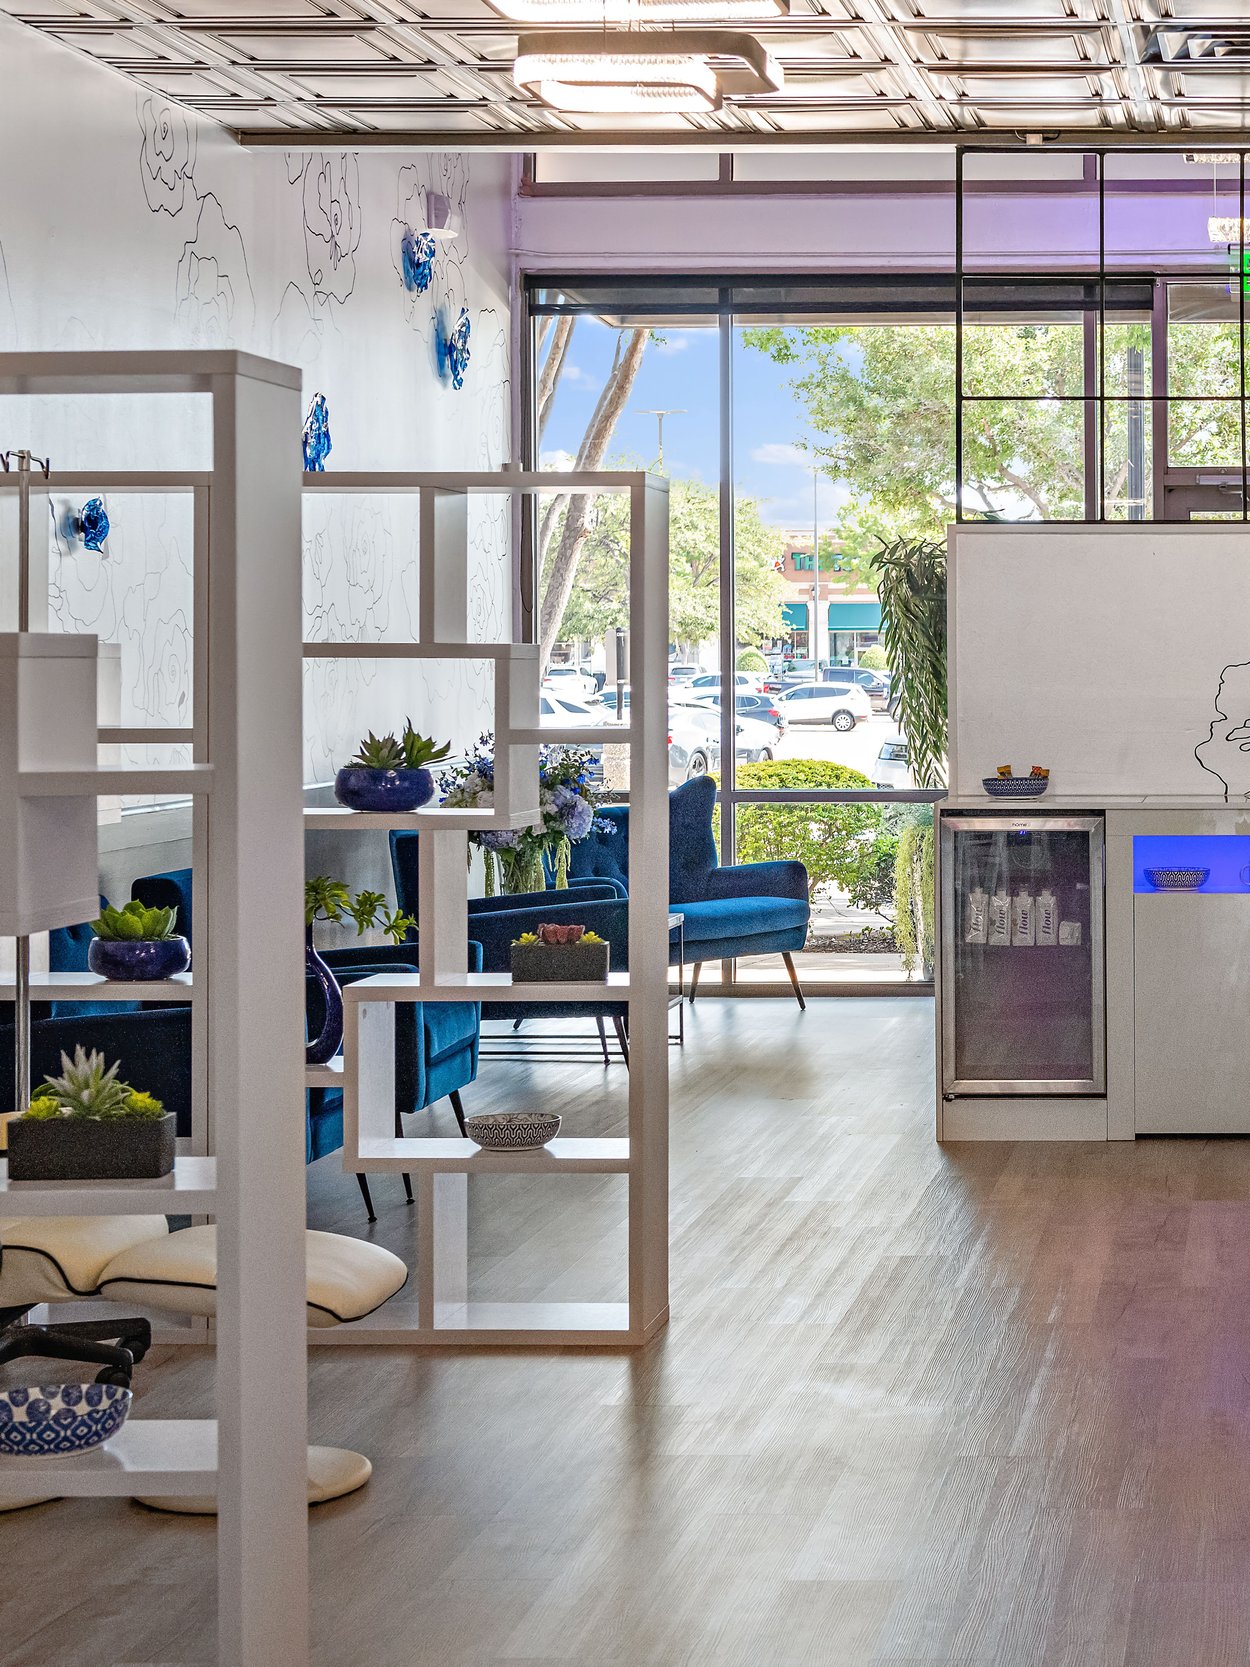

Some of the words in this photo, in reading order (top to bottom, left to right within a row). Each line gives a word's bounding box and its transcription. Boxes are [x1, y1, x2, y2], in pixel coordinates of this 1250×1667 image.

[971, 906, 983, 932] flow
[995, 909, 1007, 935] flow
[1018, 909, 1029, 935] flow
[1042, 909, 1052, 935] flow
